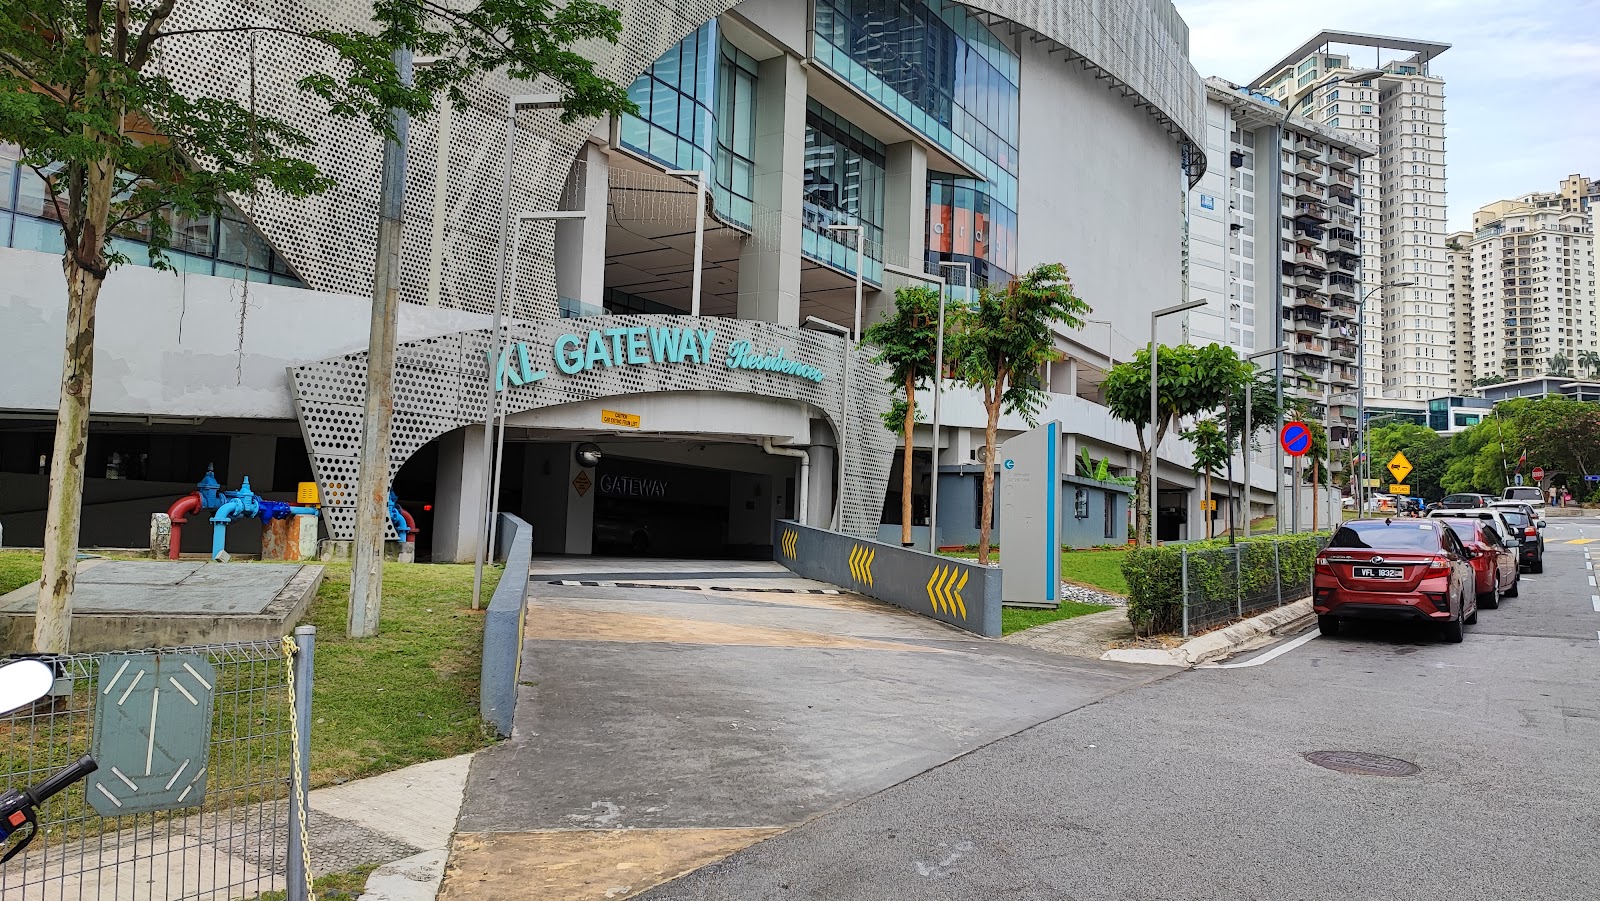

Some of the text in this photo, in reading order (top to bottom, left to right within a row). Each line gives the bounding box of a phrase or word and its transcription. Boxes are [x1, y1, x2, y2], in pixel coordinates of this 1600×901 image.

[486, 326, 825, 391] KL GATEWAY Residences
[600, 474, 668, 497] GATEWAY
[1361, 568, 1395, 577] VFL 1832
